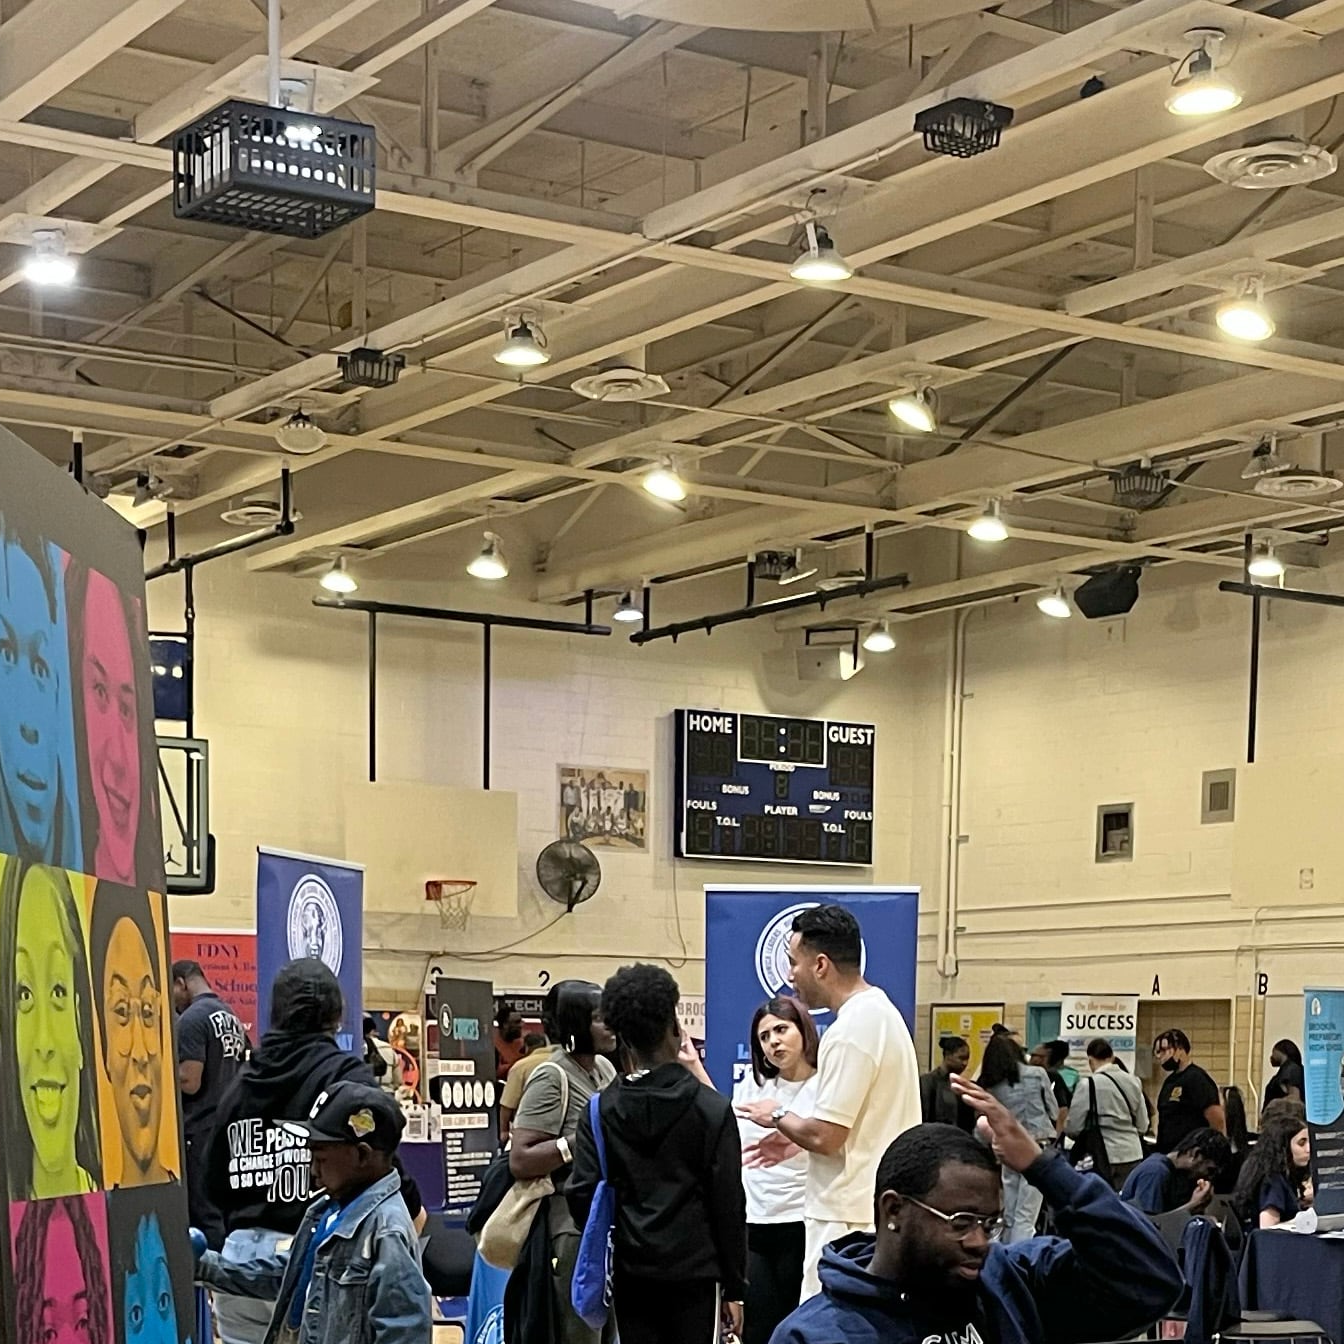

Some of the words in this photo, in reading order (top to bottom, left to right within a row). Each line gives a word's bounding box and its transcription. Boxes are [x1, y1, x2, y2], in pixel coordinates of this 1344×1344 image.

[689, 714, 733, 734] HOME
[828, 725, 874, 745] GUEST
[721, 784, 750, 795] BONUS
[812, 790, 840, 801] BONUS
[687, 800, 717, 811] FOULS
[764, 804, 798, 816] PLAYER
[844, 810, 873, 821] FOULS
[197, 943, 239, 957] FDNY
[214, 978, 258, 993] Schoo
[1151, 974, 1161, 996] A
[1258, 973, 1269, 995] B
[505, 999, 543, 1012] TECH
[678, 1002, 706, 1016] BROO
[1066, 1014, 1135, 1031] SUCCESS
[309, 1090, 329, 1119] C
[239, 1154, 275, 1172] CHANGE
[240, 1173, 254, 1188] SO
[255, 1171, 274, 1187] CAN
